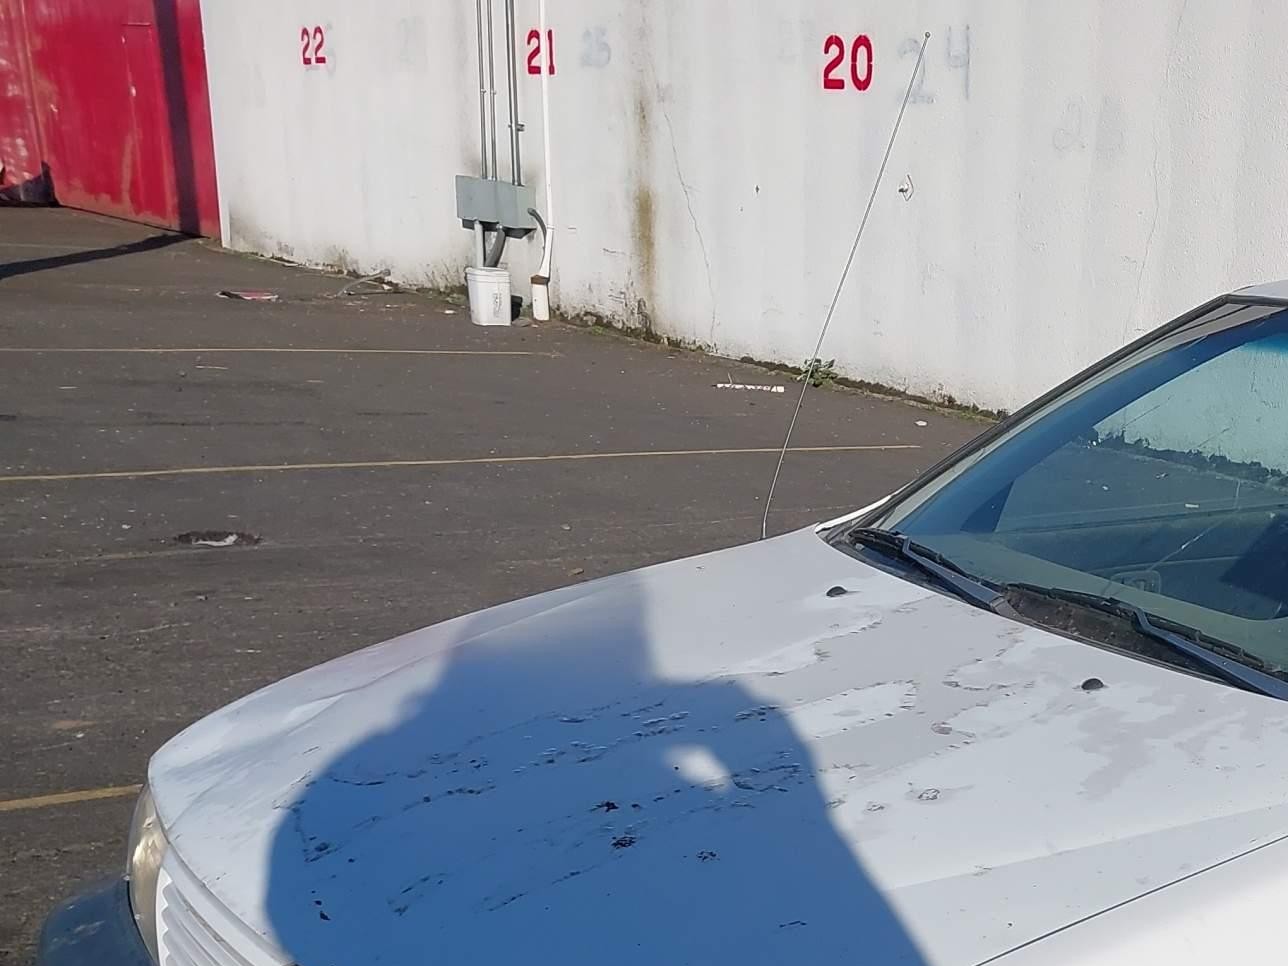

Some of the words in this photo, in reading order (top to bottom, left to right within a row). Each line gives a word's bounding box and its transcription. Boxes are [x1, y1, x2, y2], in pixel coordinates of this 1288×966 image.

[302, 27, 326, 65] 22
[526, 30, 555, 76] 21
[822, 34, 874, 92] 20
